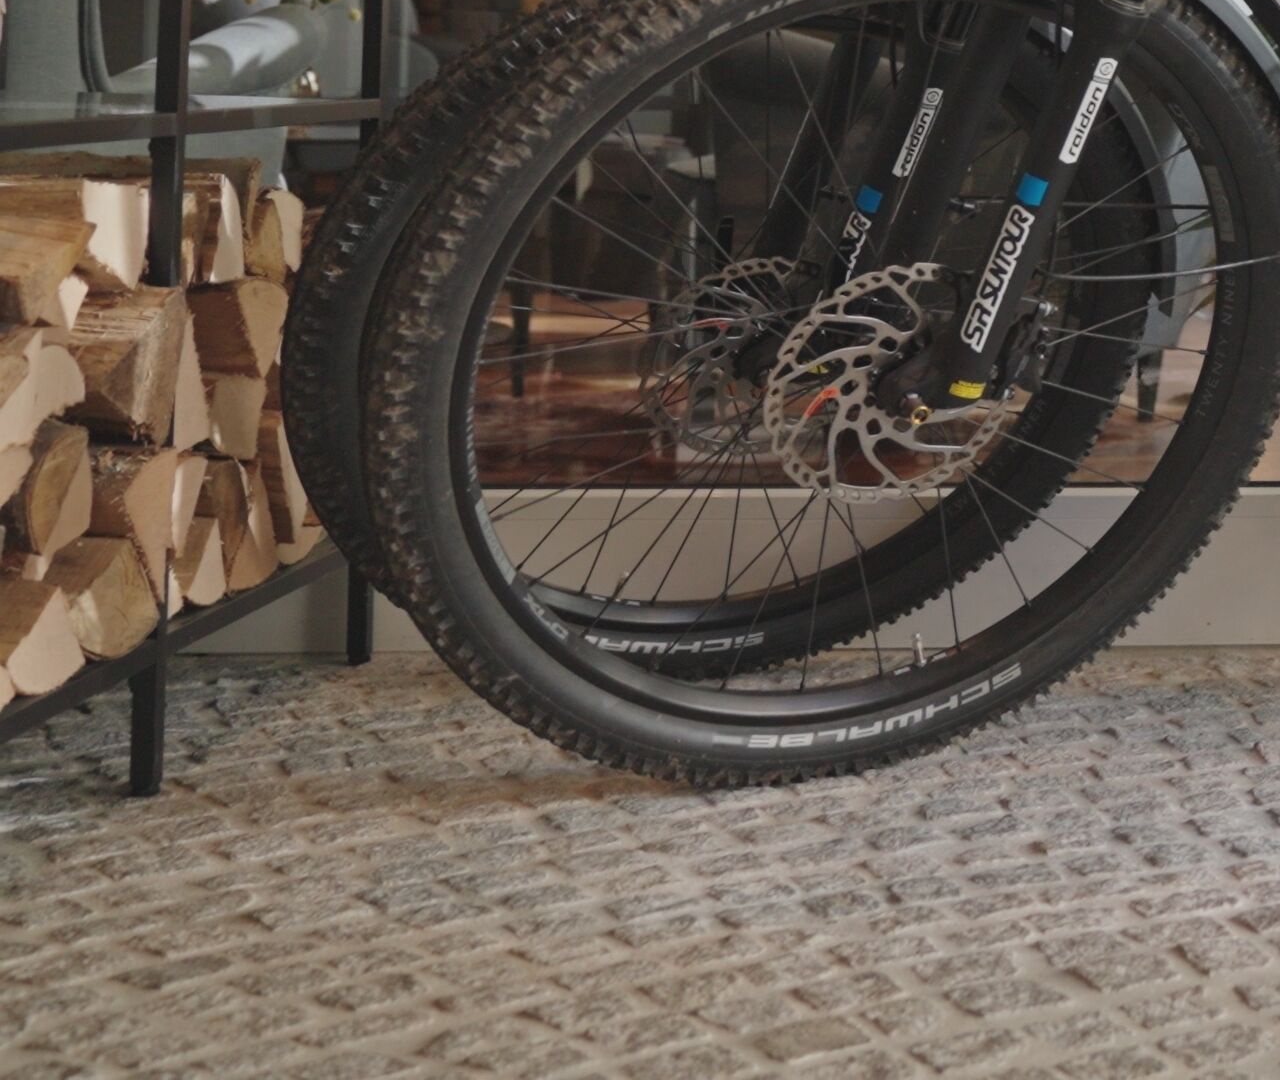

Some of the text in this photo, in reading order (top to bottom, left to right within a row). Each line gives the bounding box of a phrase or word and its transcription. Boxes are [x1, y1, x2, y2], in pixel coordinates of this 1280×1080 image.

[1068, 86, 1103, 157] raidon
[977, 205, 1034, 308] SUNTOUR
[1194, 338, 1229, 418] TWENTY
[584, 631, 765, 655] SCHWA
[746, 661, 1023, 750] SCHWALBE
